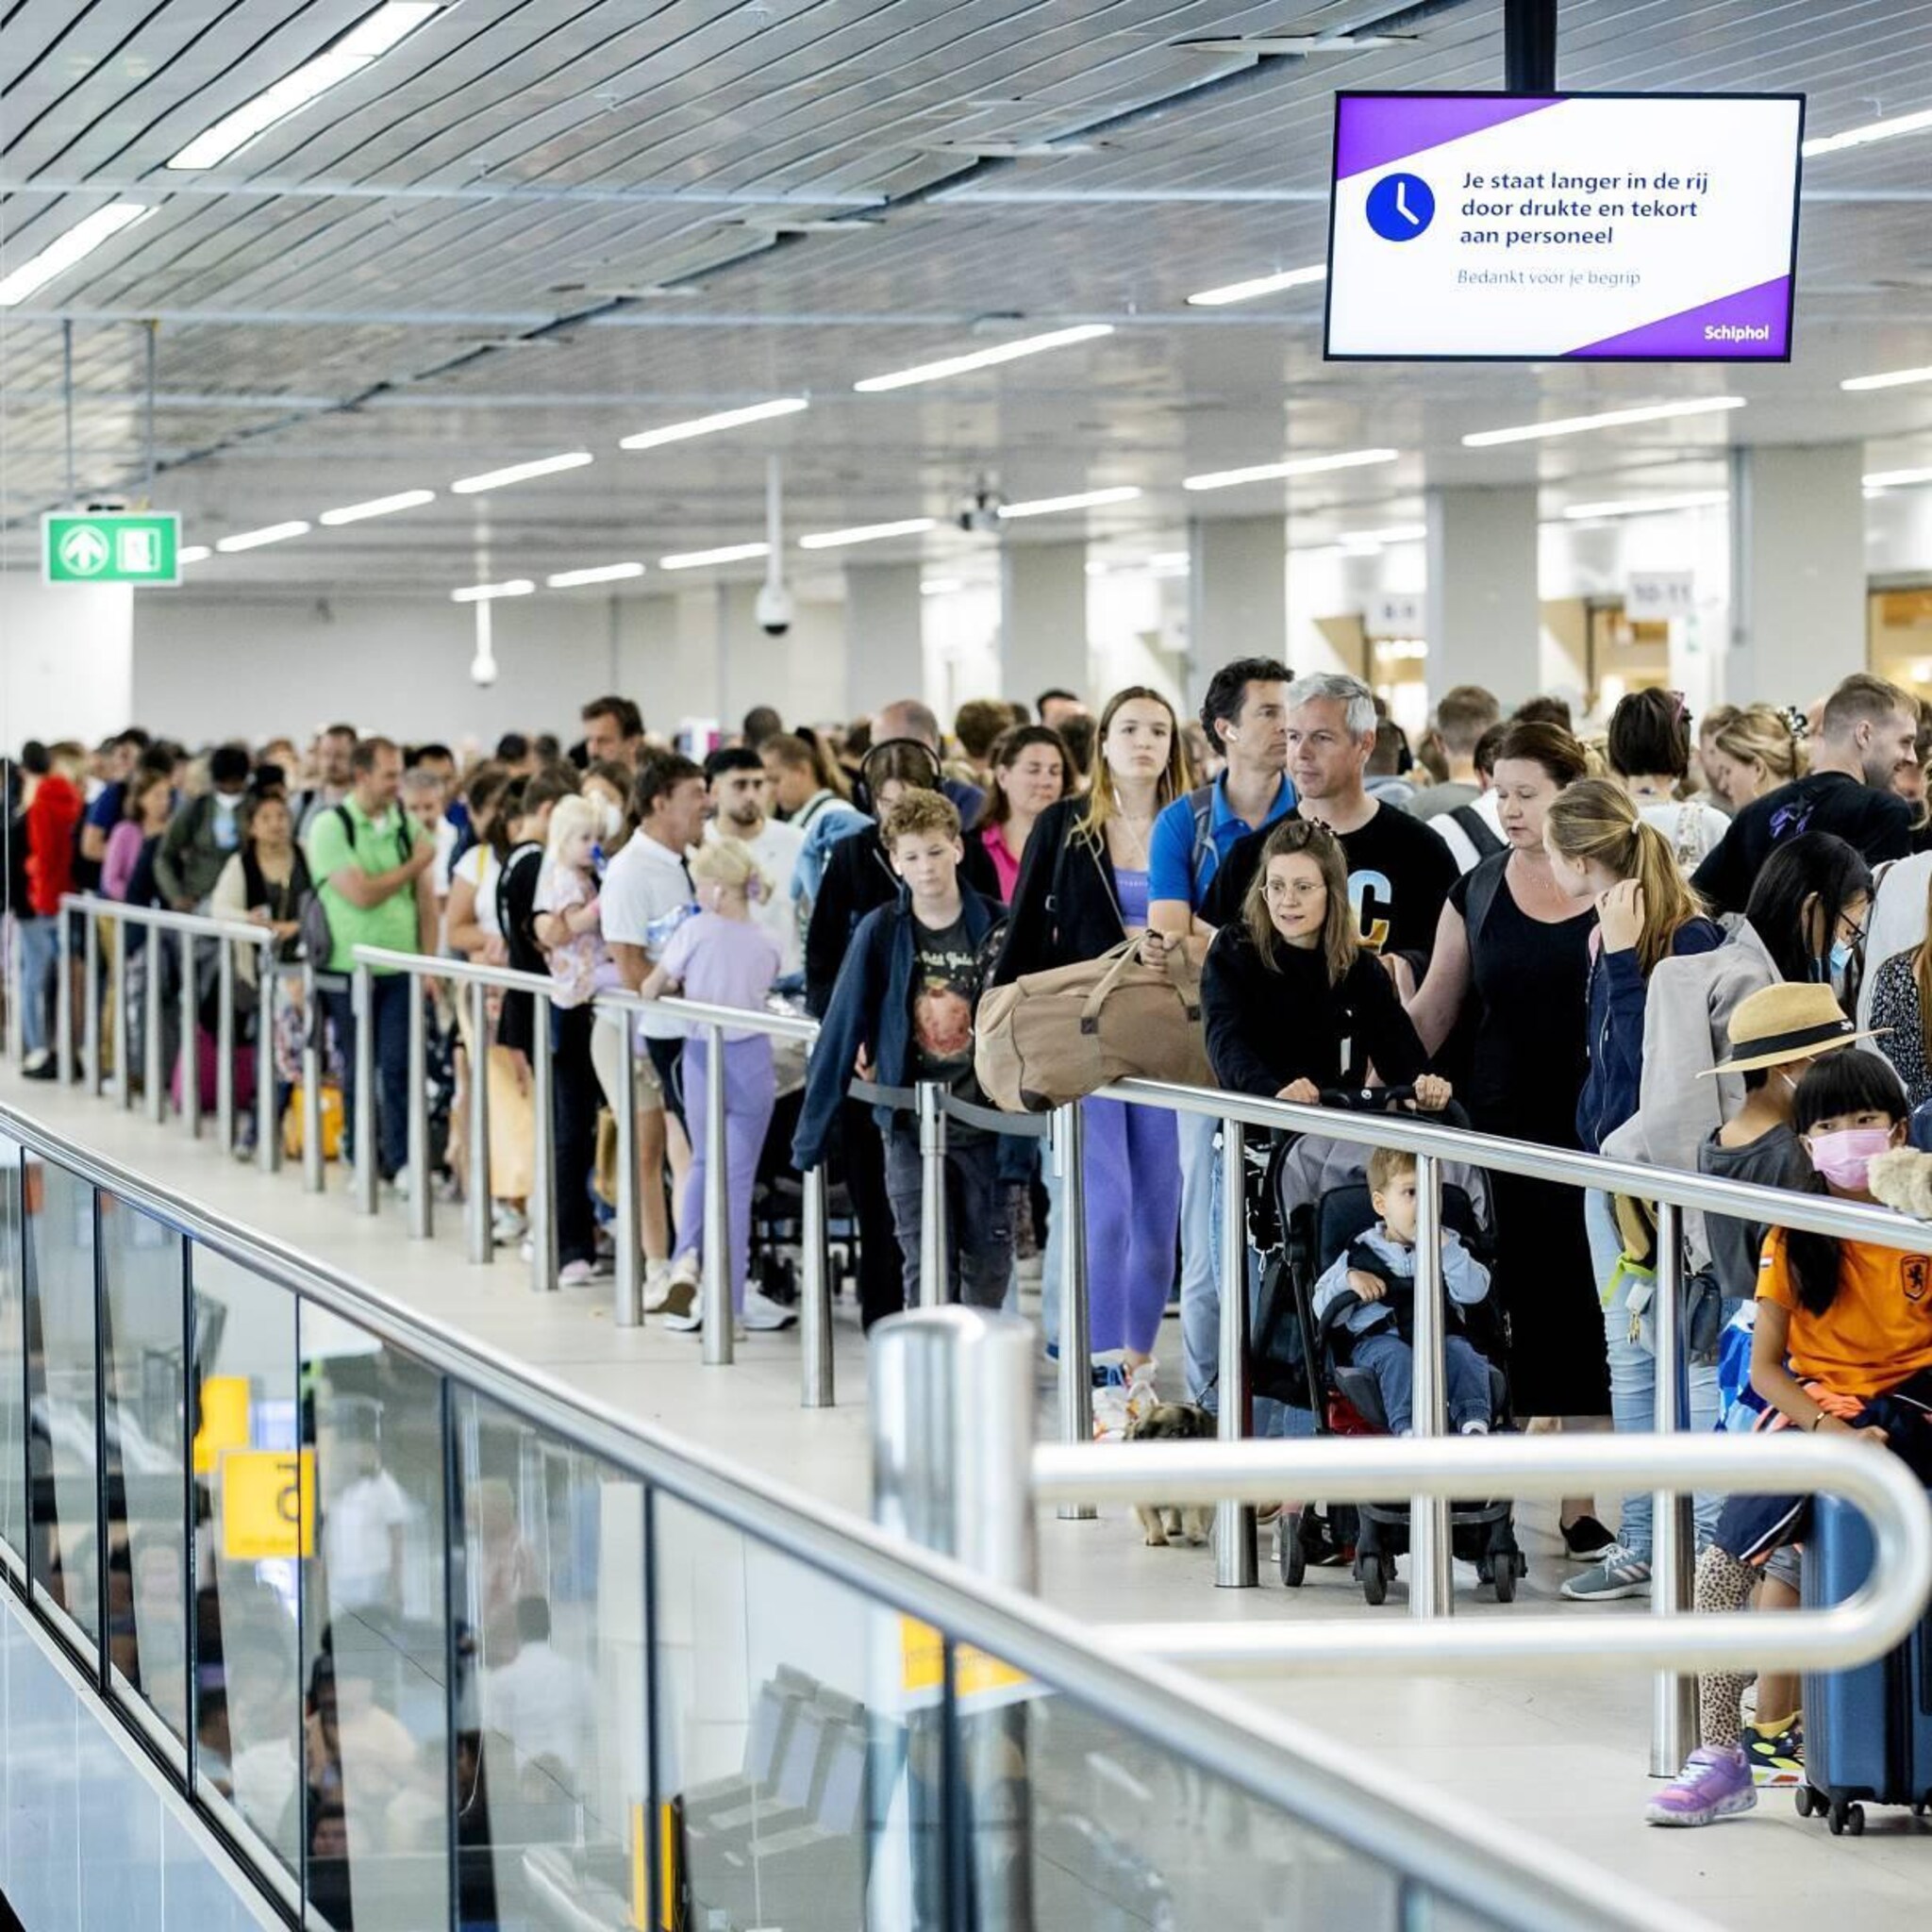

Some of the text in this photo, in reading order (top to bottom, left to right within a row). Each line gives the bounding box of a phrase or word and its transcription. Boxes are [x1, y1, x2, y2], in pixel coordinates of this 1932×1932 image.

[1462, 172, 1708, 194] Je staat langer in de rij
[1461, 198, 1698, 217] door drukte en tekort
[1460, 226, 1613, 248] aan personeel
[1457, 269, 1641, 289] Bedankt voor je begrip
[1705, 325, 1770, 342] Schiphol
